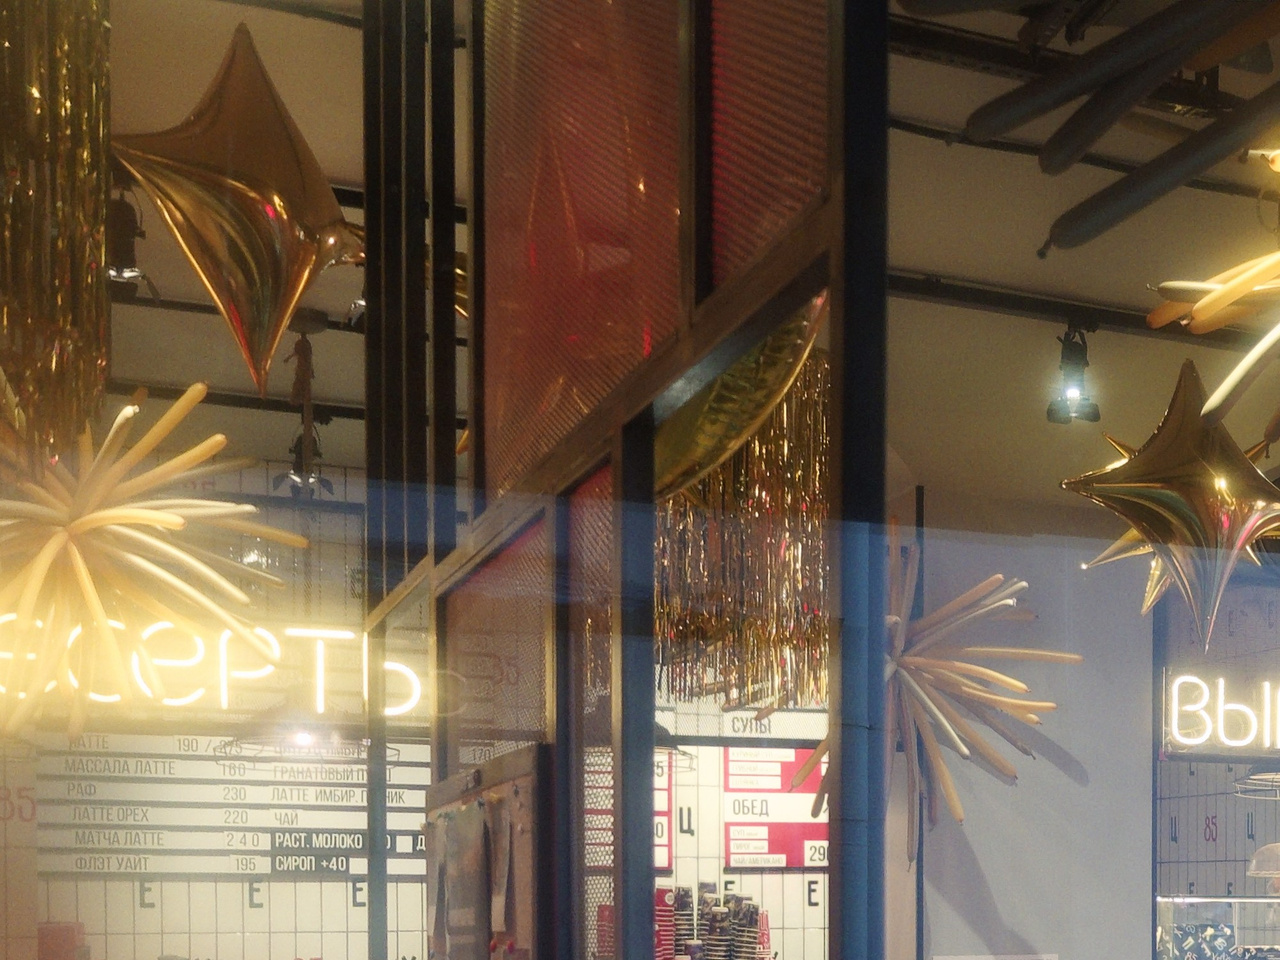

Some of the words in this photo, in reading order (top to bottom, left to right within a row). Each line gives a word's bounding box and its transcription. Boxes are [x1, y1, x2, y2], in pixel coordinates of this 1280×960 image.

[732, 716, 771, 734] СУПЫ
[176, 738, 199, 752] 190
[64, 758, 130, 775] МАССАЛА
[134, 760, 176, 776] ЛАТТЕ
[273, 765, 354, 782] ГРАНАТОВЫЙ
[67, 782, 97, 797] РАФ
[223, 786, 247, 801] 230
[271, 787, 309, 803] ЛАТТЕ
[315, 789, 359, 804] ИМБИР.
[72, 807, 113, 822] ЛАТТЕ
[117, 808, 149, 823] ОРЕХ
[223, 810, 249, 825] 220
[732, 799, 769, 817] ОБЕД
[274, 810, 299, 826] ЧАЙ
[74, 830, 120, 846] МАТЧА
[123, 831, 164, 847] ЛАТТЕ
[275, 833, 309, 848] РАСТ.
[312, 834, 363, 849] МОЛОКО
[75, 856, 112, 871] ФЛЭТ
[235, 857, 256, 871] 195
[275, 857, 315, 871] СИРОП
[320, 857, 347, 871] +40
